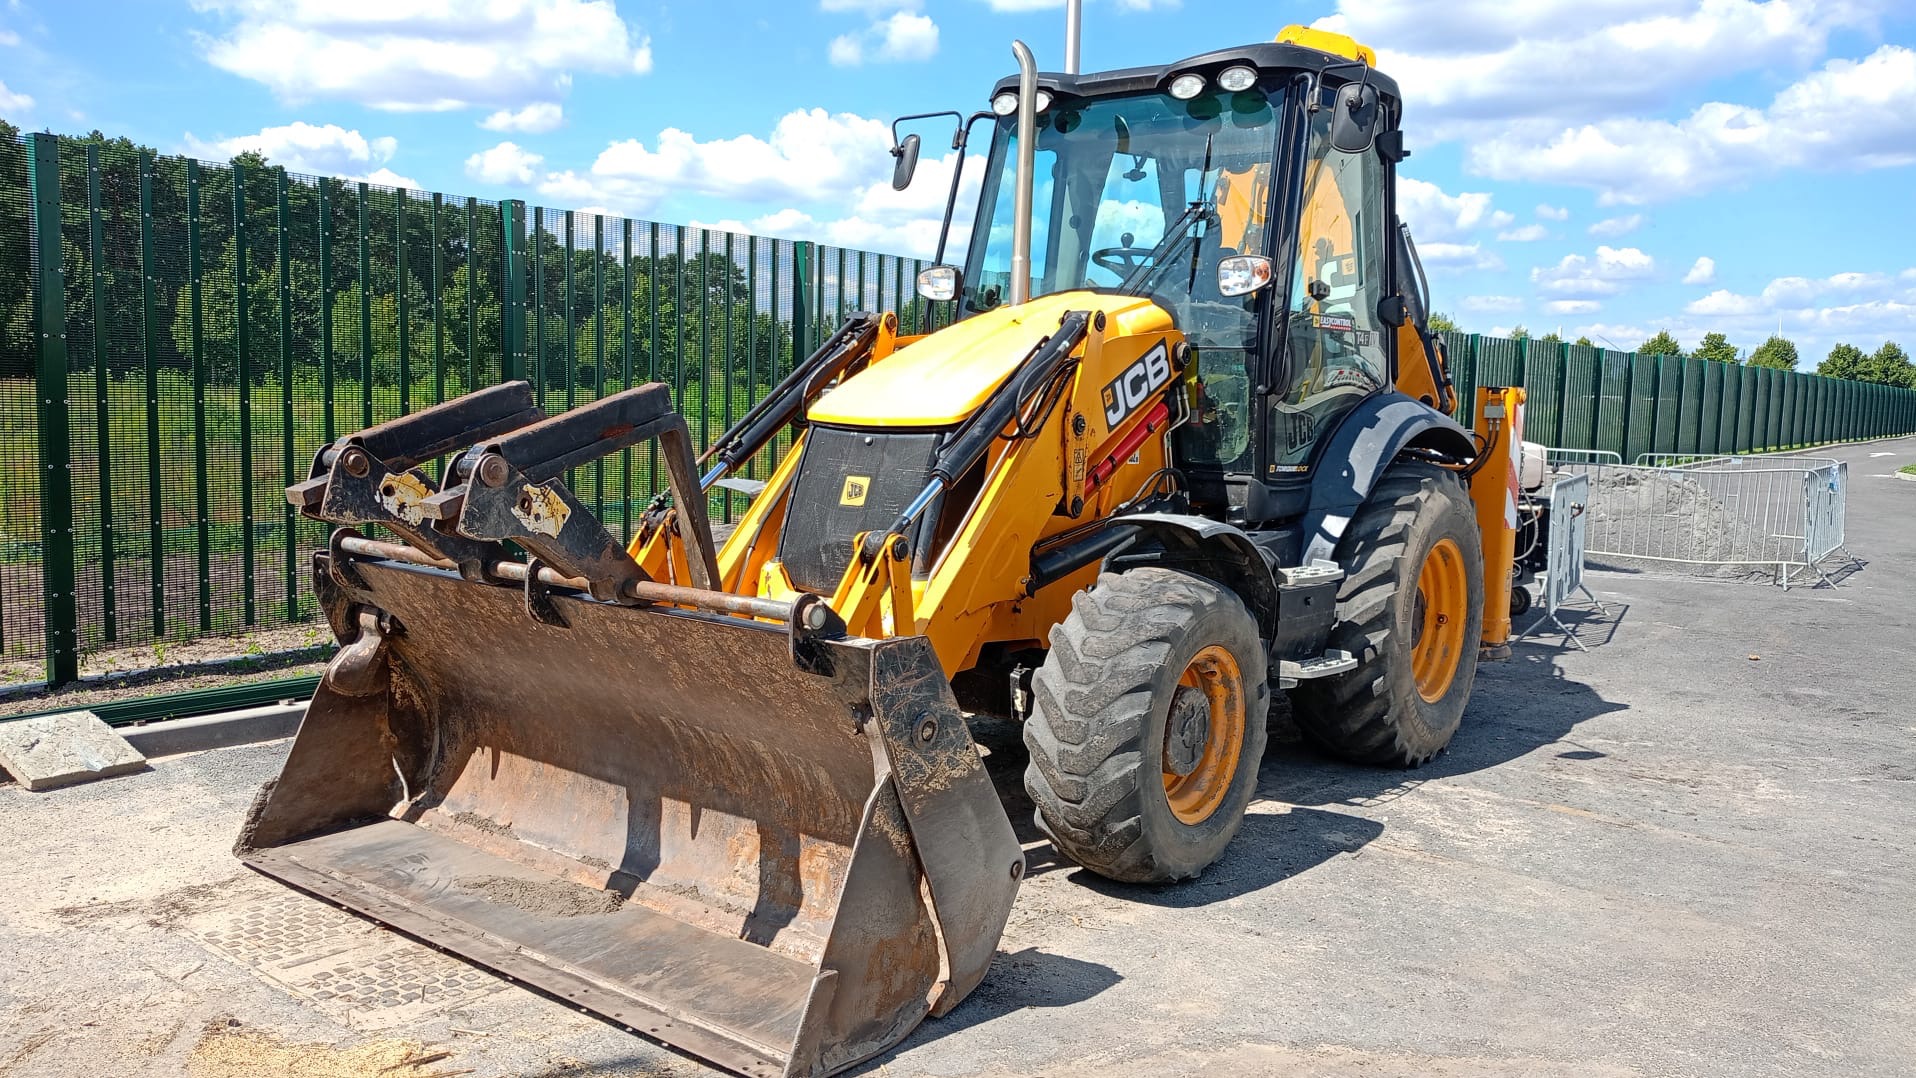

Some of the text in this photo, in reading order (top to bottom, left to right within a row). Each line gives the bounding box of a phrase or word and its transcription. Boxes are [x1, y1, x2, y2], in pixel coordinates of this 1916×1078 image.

[1107, 345, 1169, 426] JCB
[1288, 413, 1313, 449] JCB
[848, 483, 864, 498] JCB
